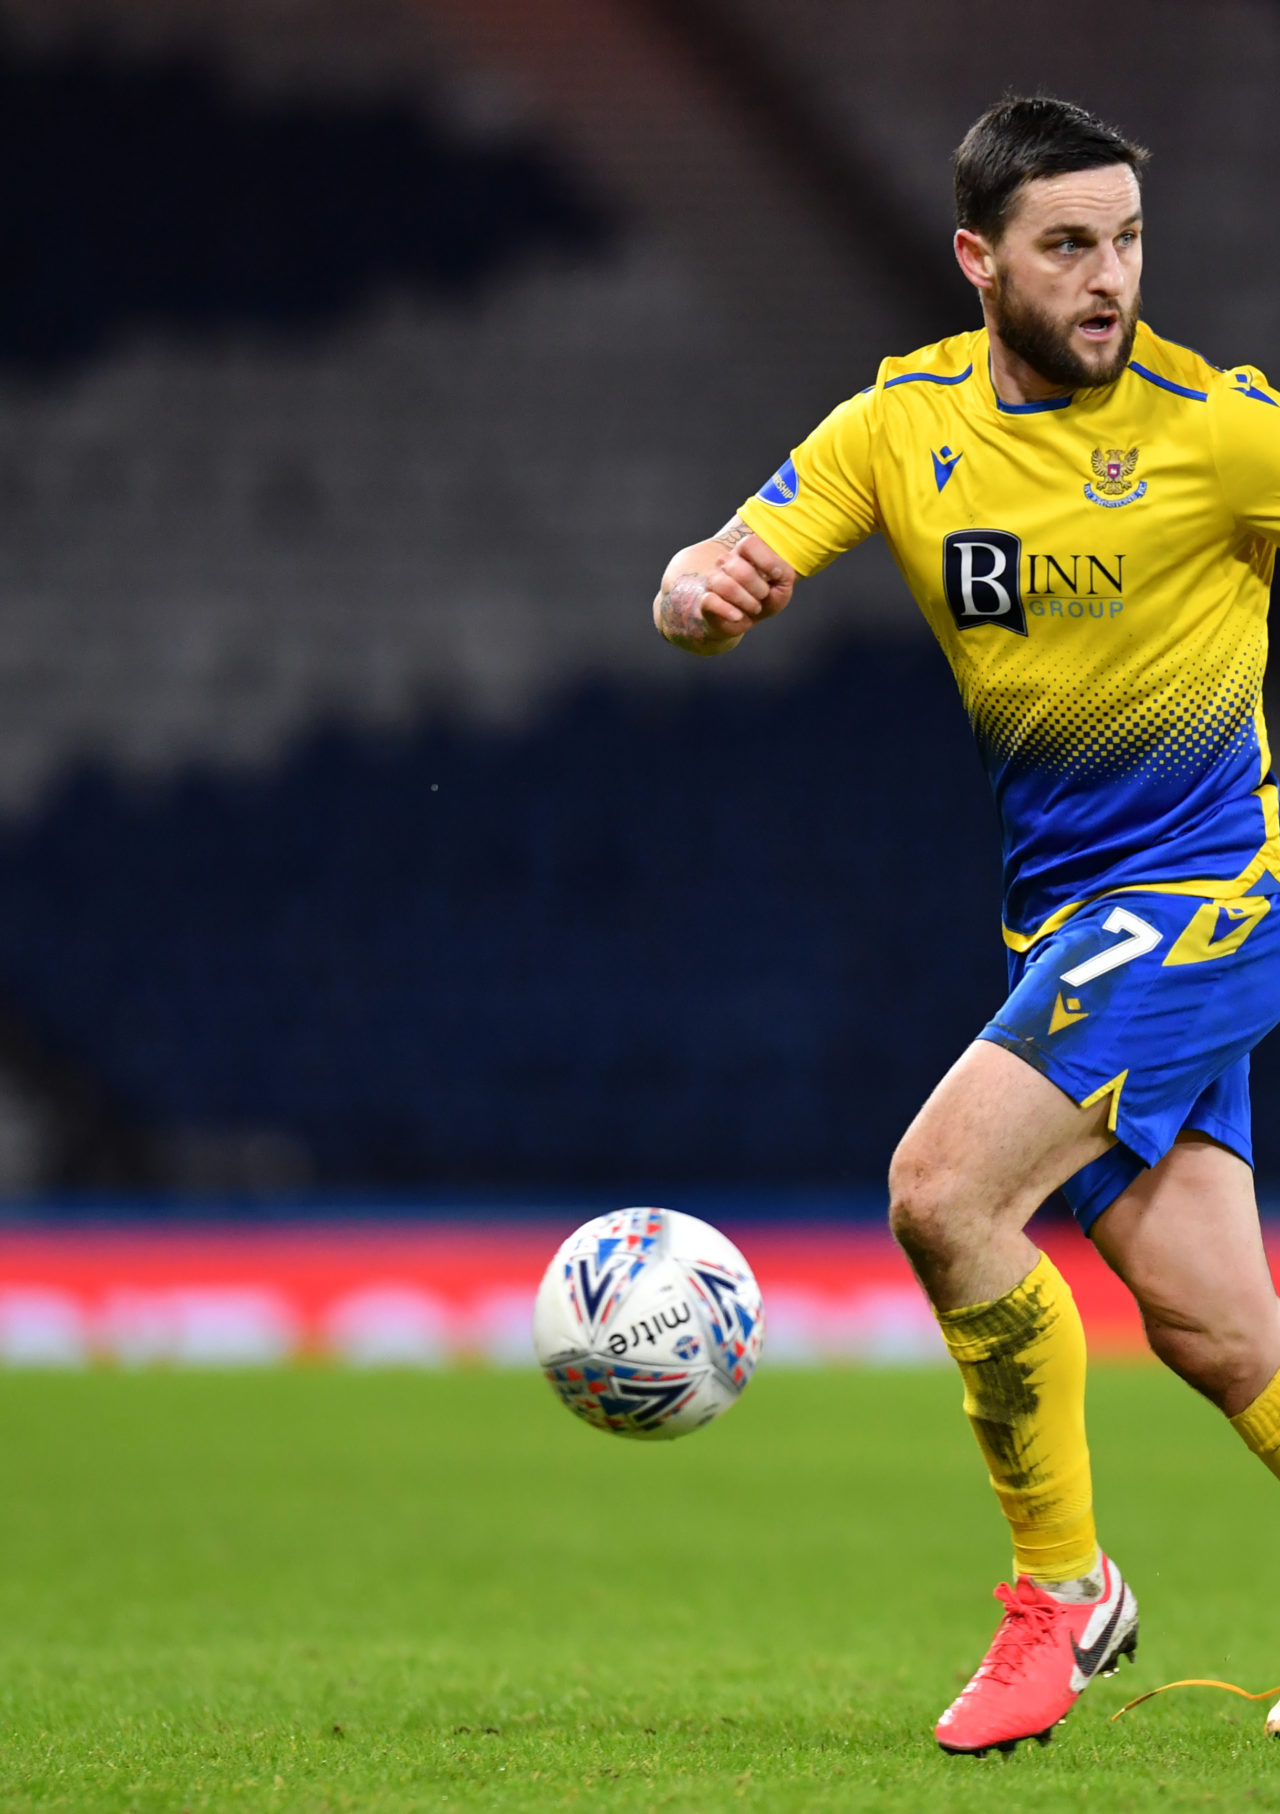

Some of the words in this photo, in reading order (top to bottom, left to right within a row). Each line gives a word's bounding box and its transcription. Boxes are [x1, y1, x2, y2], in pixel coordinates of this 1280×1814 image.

[952, 542, 1126, 616] BINN
[1028, 599, 1125, 619] GROUP
[1060, 906, 1164, 988] 7
[608, 1301, 691, 1355] mitre
